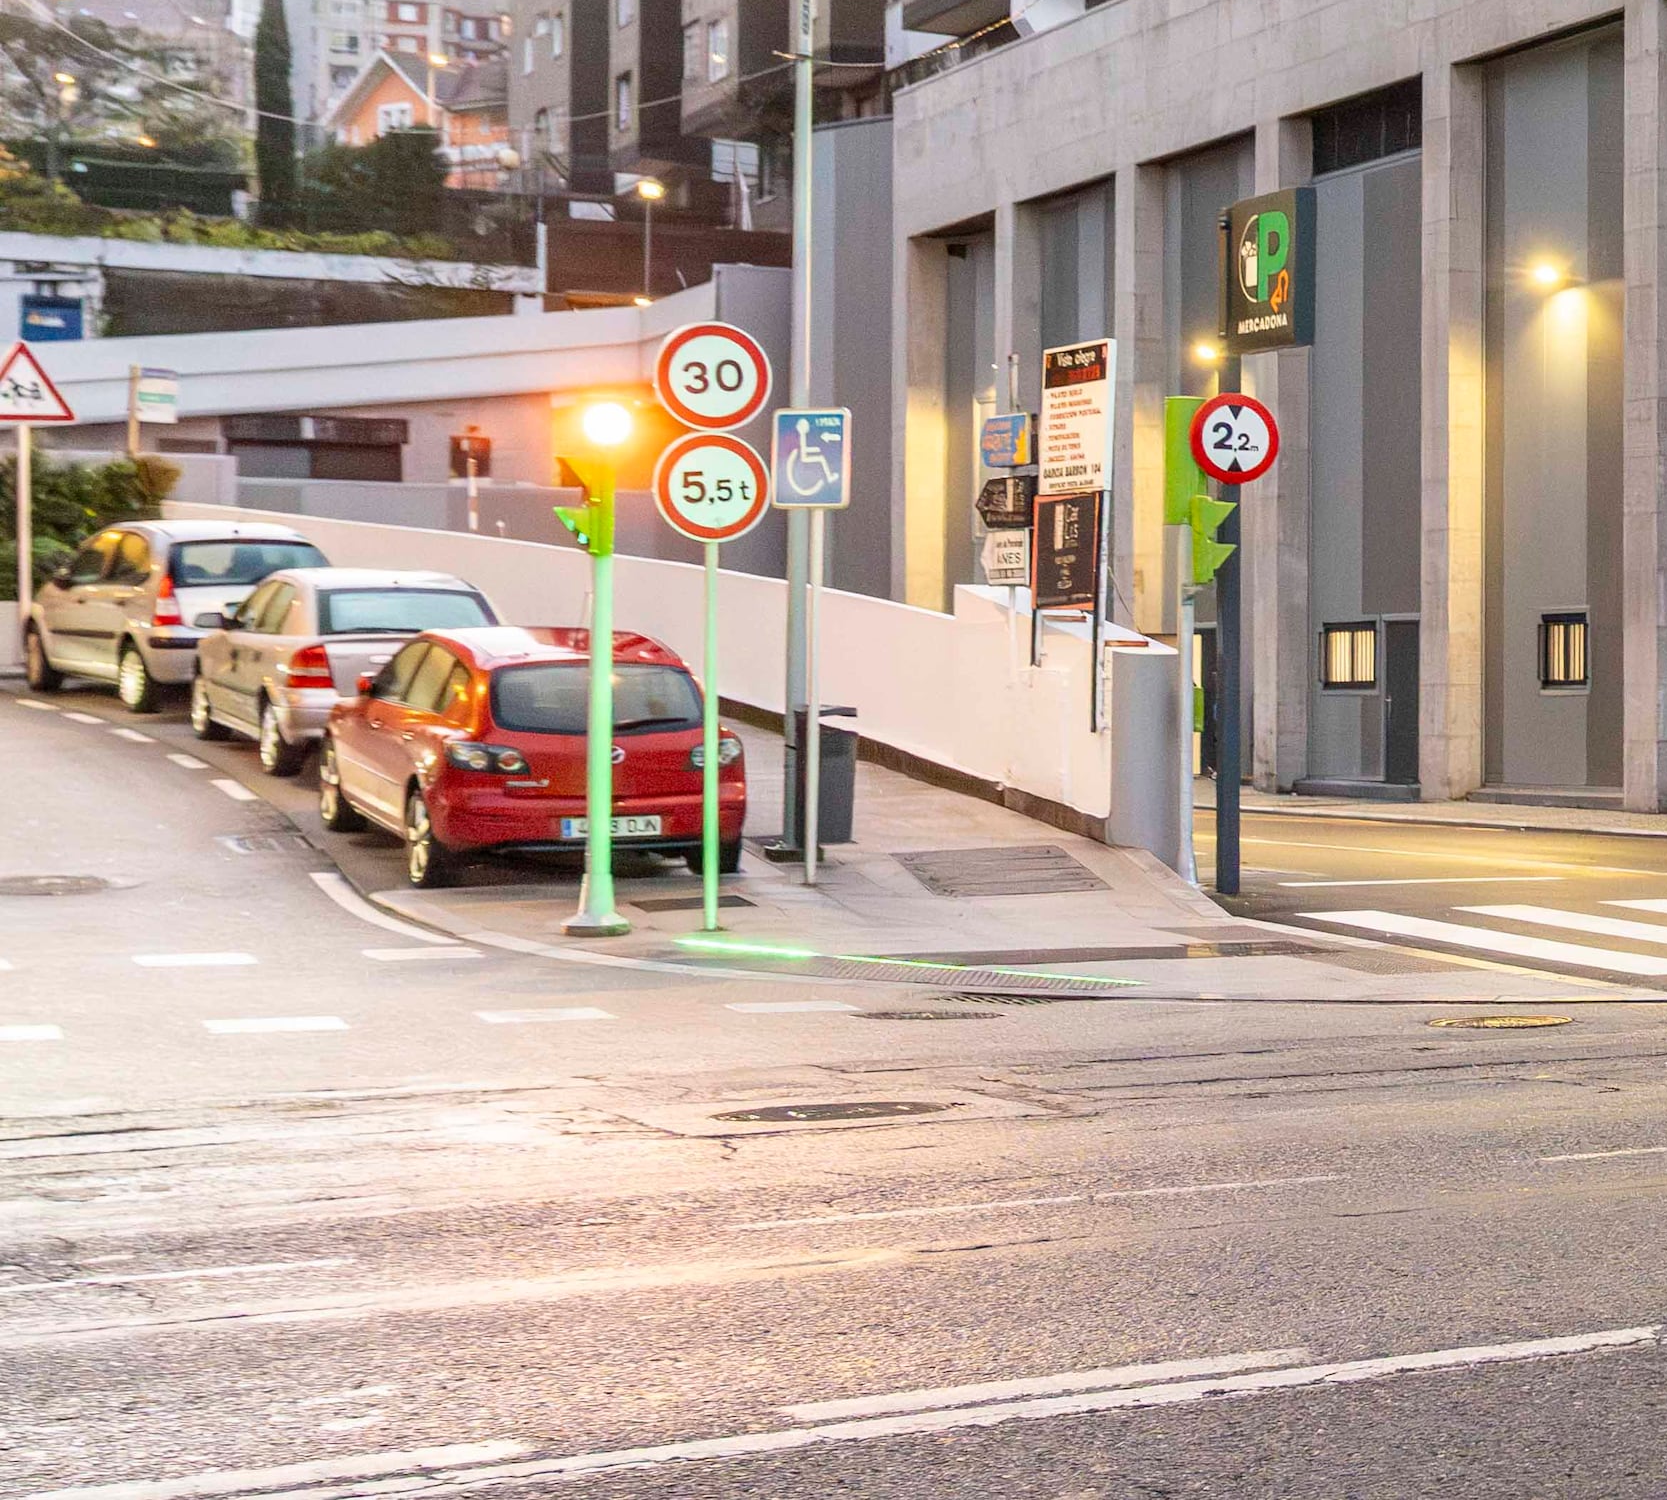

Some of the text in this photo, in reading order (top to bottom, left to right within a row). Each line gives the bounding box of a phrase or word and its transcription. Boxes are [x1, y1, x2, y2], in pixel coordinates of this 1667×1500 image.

[1238, 314, 1288, 335] MERCADONA
[683, 359, 743, 394] 30
[683, 471, 732, 504] 5,5
